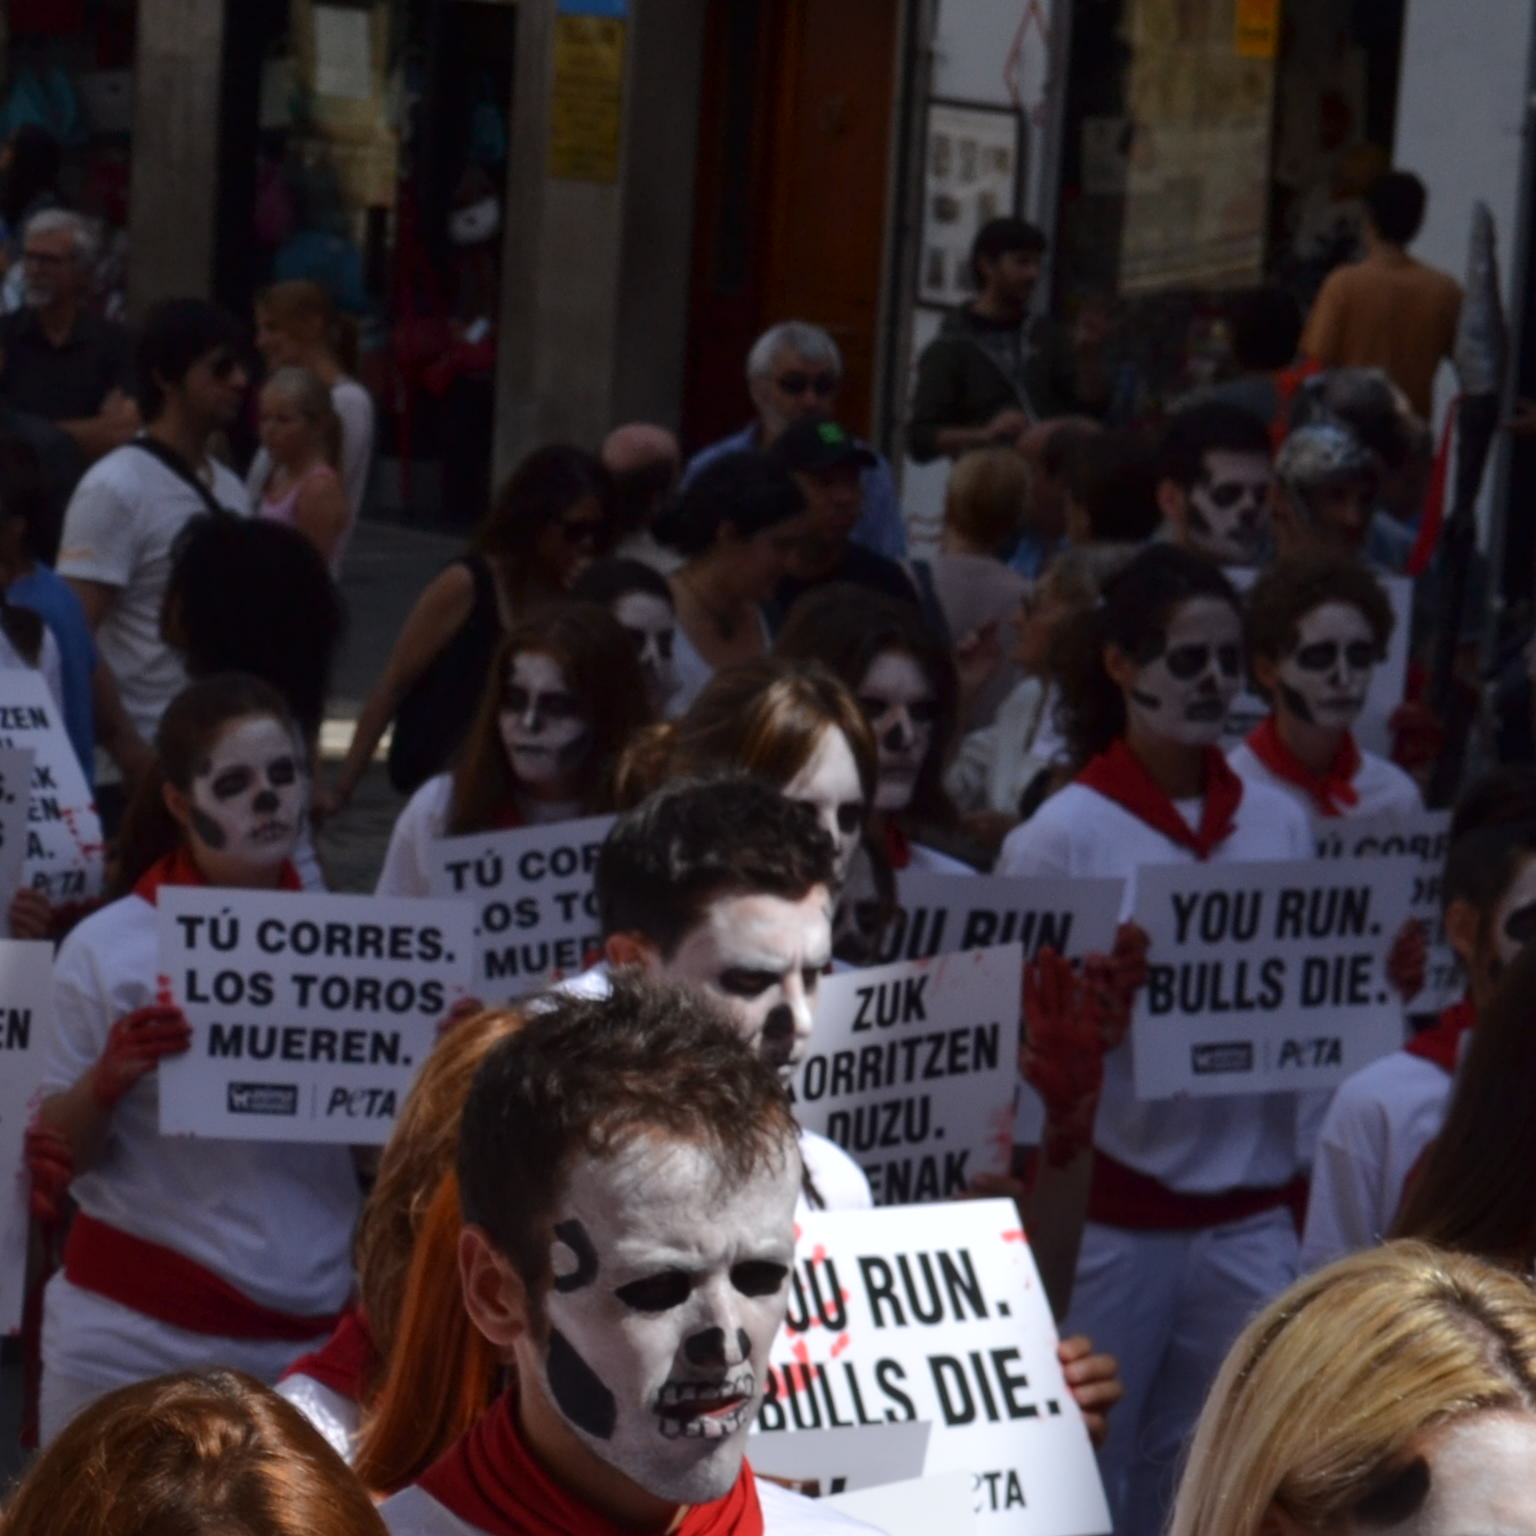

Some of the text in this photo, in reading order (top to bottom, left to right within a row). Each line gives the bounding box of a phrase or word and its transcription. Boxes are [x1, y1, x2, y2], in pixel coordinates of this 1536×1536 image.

[445, 849, 503, 892] TÚ
[176, 908, 239, 951] TÚ
[256, 919, 455, 963] CORRES.
[1171, 888, 1263, 945] YOU
[1274, 885, 1382, 941] RUN.
[185, 969, 445, 1015] LOS TOROS
[851, 974, 931, 1032] ZUK
[1148, 953, 1388, 1017] BULLS DIE.
[208, 1023, 413, 1067] MUEREN.
[790, 1022, 1001, 1103] ORRITZEN
[856, 1247, 1011, 1330] RUN.
[758, 1346, 1062, 1432] BULLS DIE.
